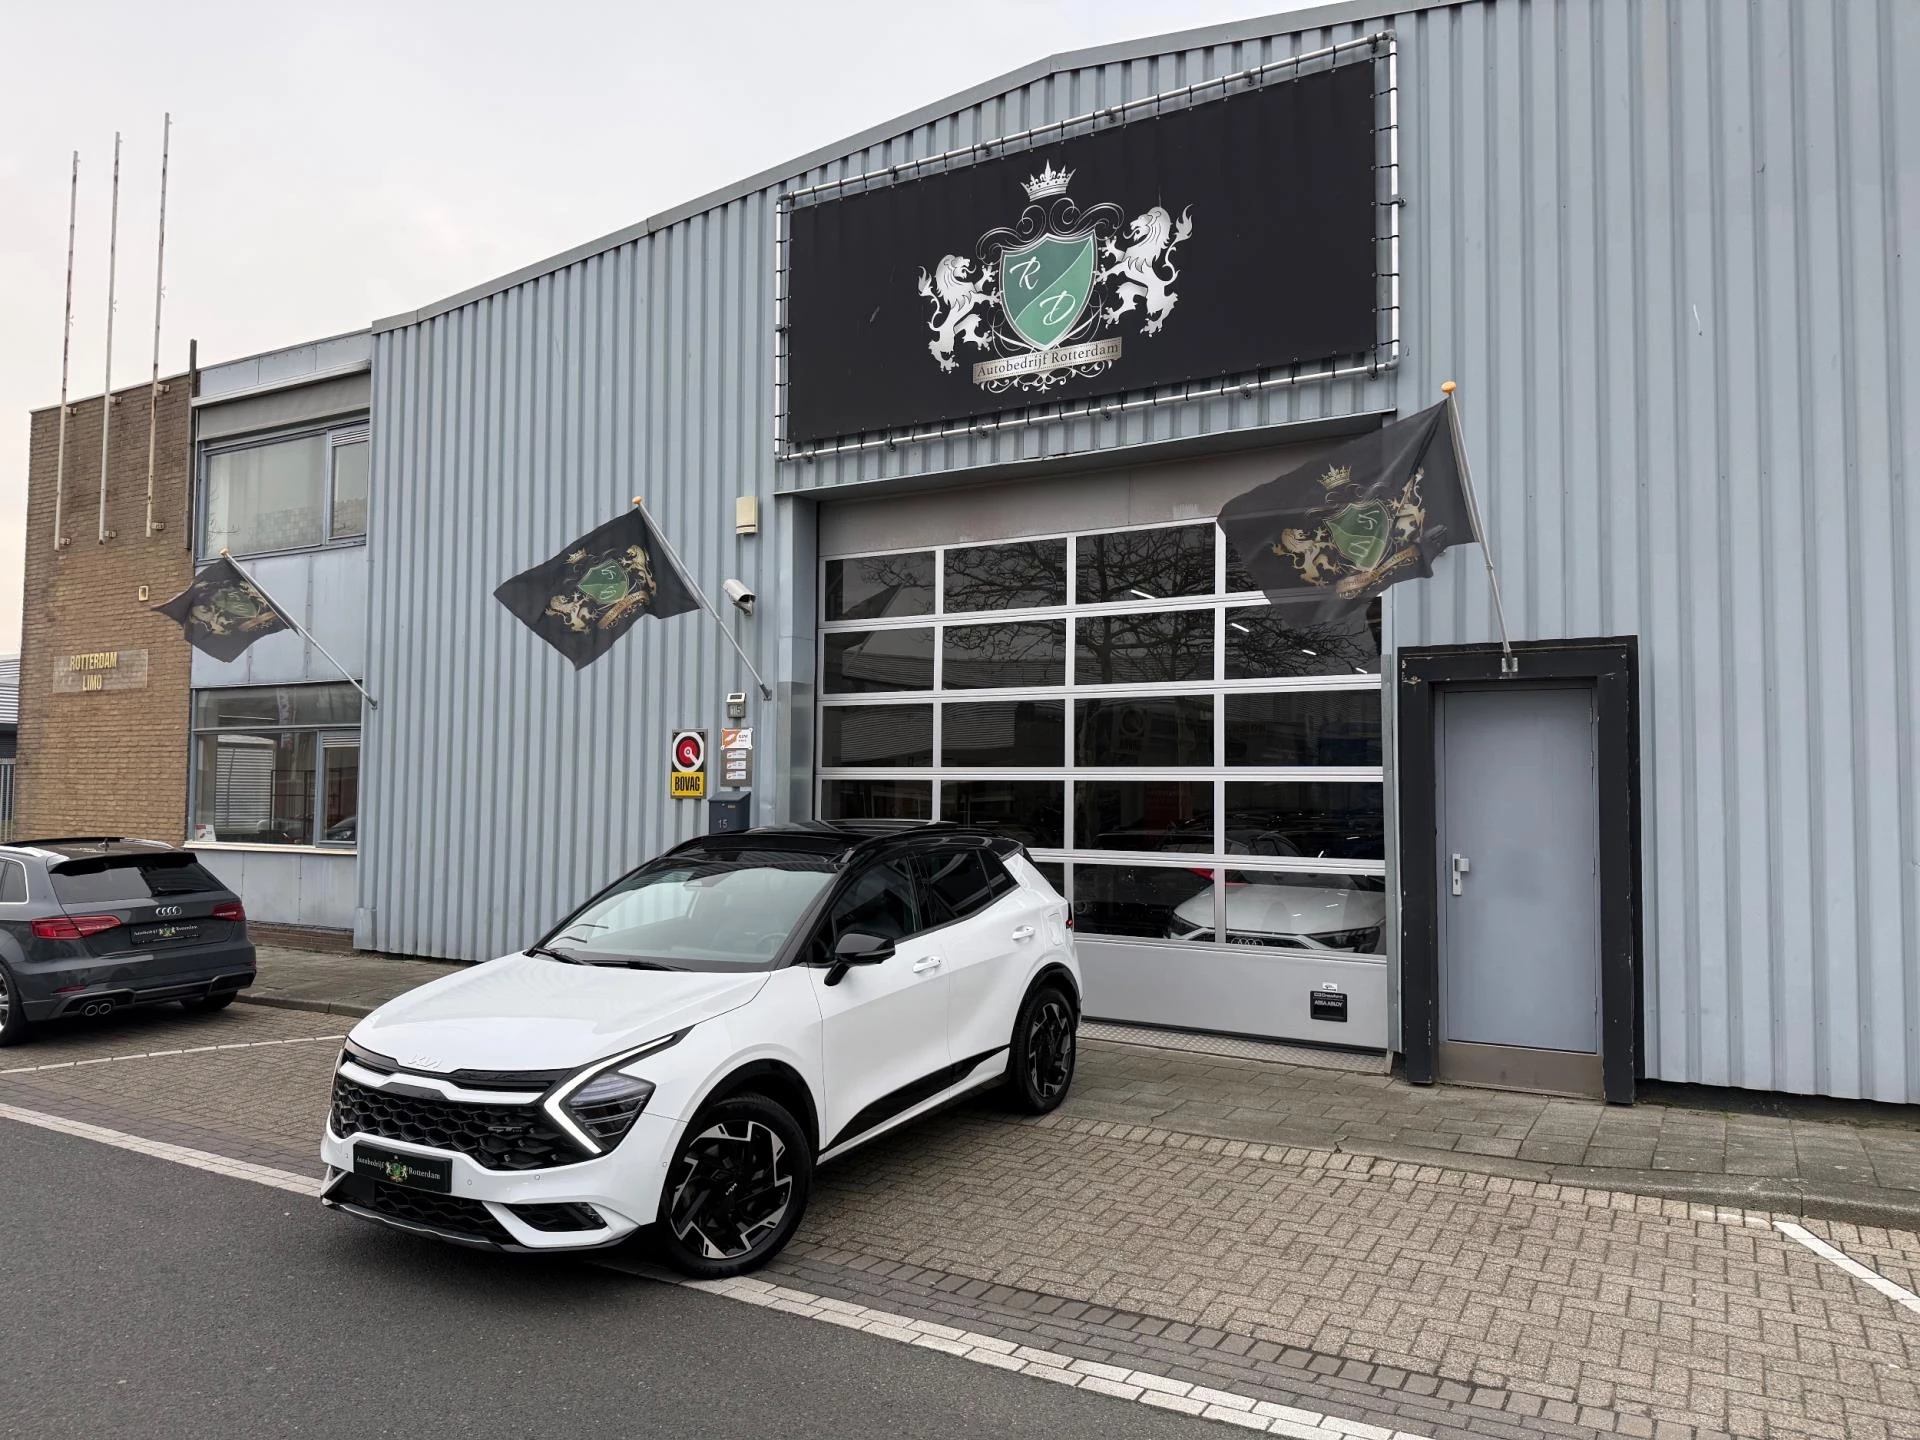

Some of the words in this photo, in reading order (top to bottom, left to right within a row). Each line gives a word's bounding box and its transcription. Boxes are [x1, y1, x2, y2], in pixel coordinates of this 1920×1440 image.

[1009, 256, 1041, 290] R
[1039, 290, 1076, 326] D
[978, 353, 1049, 377] Autobedrijf
[1051, 344, 1119, 362] Rotterdam
[69, 652, 118, 671] ROTTERDAM
[82, 674, 103, 691] LIMO
[674, 776, 701, 792] BOVAG
[718, 819, 728, 829] 15
[408, 1166, 441, 1180] Rotterdam
